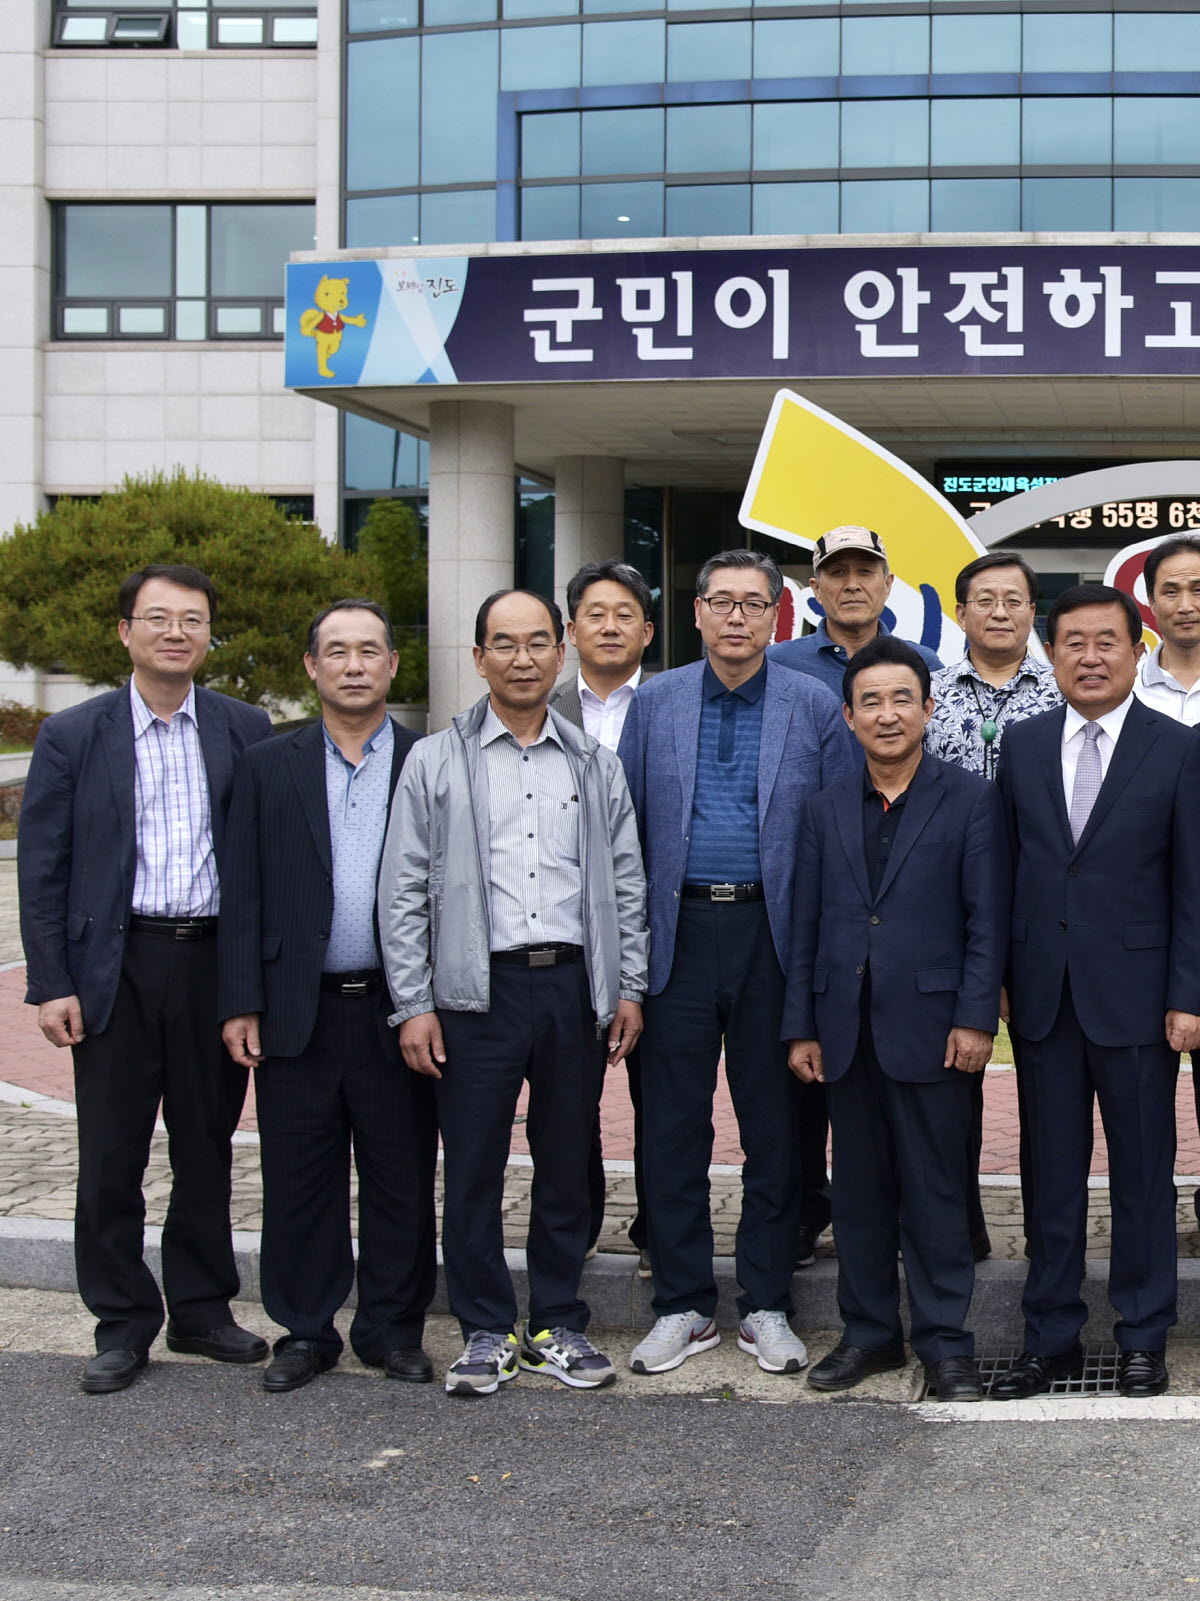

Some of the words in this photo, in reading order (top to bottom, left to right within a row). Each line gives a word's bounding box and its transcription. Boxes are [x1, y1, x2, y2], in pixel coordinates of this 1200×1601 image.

[426, 277, 461, 299] 진도
[522, 268, 790, 364] 군민이
[1102, 501, 1159, 529] 55명
